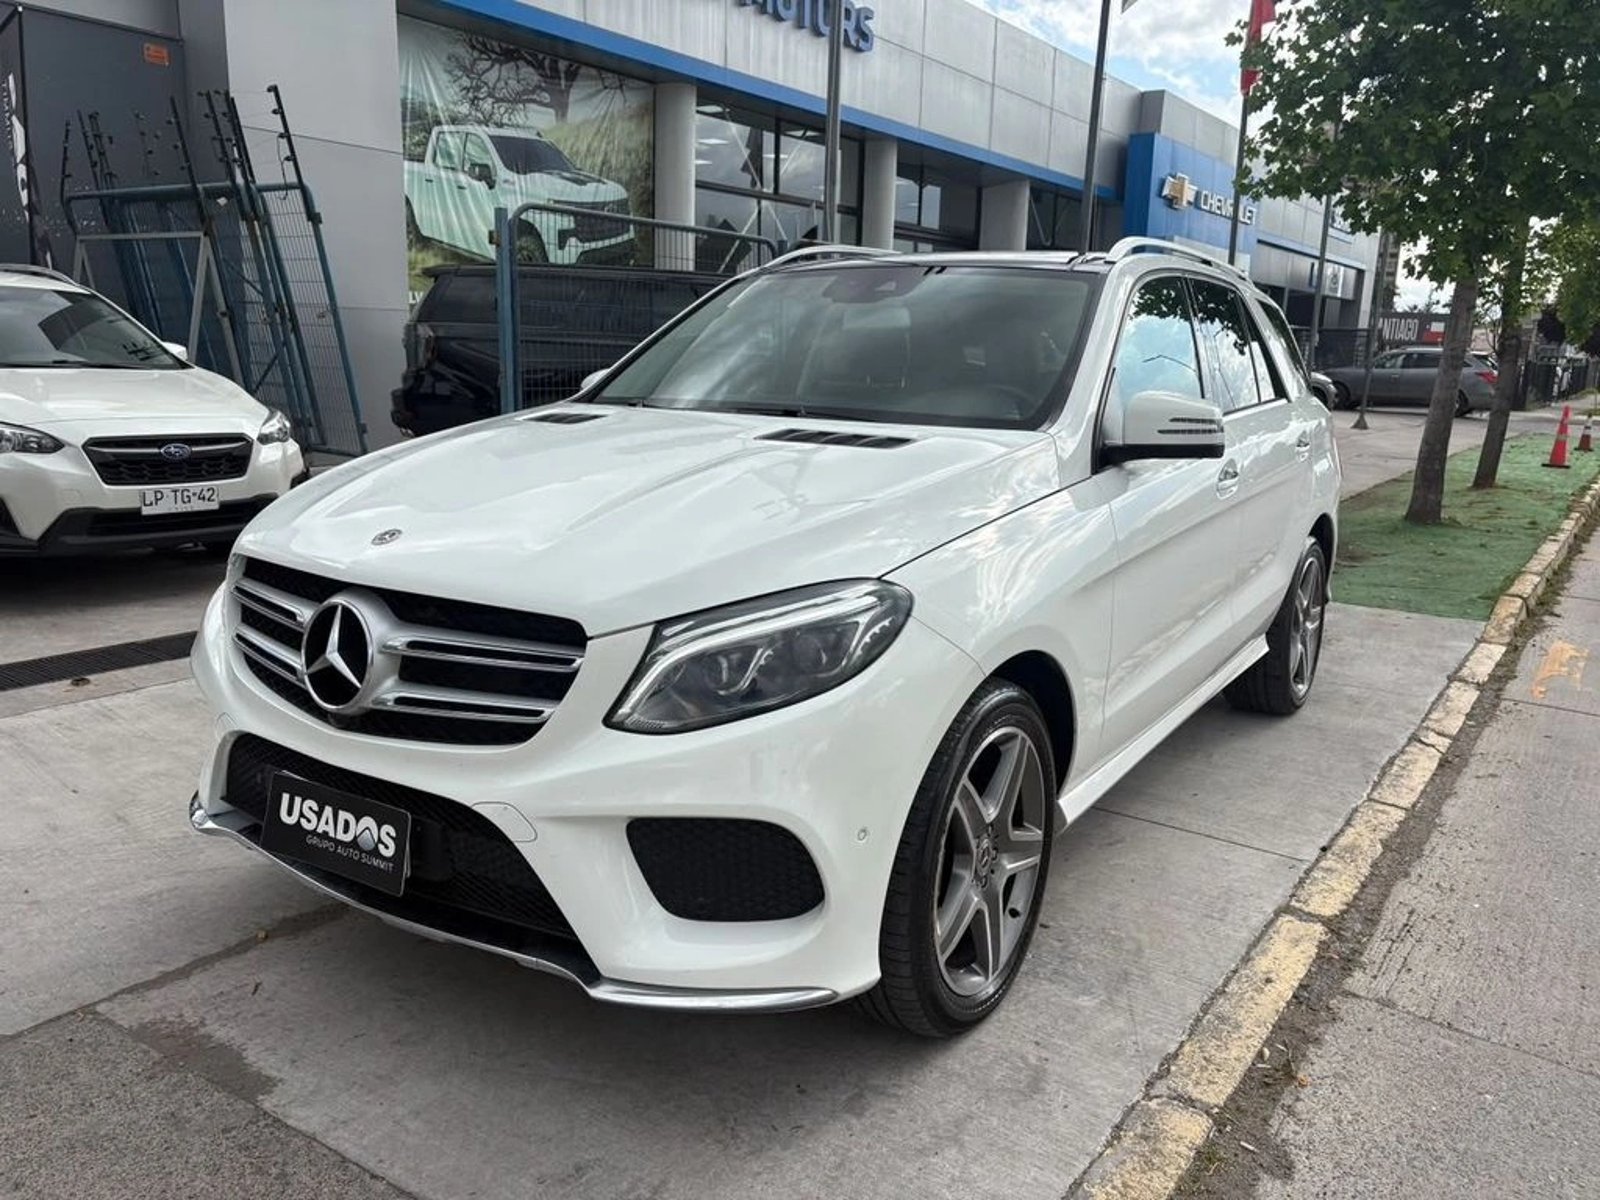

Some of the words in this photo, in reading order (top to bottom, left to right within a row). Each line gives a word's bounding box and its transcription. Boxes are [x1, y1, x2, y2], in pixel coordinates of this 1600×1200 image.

[737, 0, 875, 52] TORS
[1200, 190, 1257, 225] CHEVRLET
[142, 490, 164, 507] LP
[279, 792, 396, 858] USADOS
[306, 835, 335, 852] GRUPO
[336, 846, 360, 860] AUTO
[361, 853, 394, 873] SUMMIT
